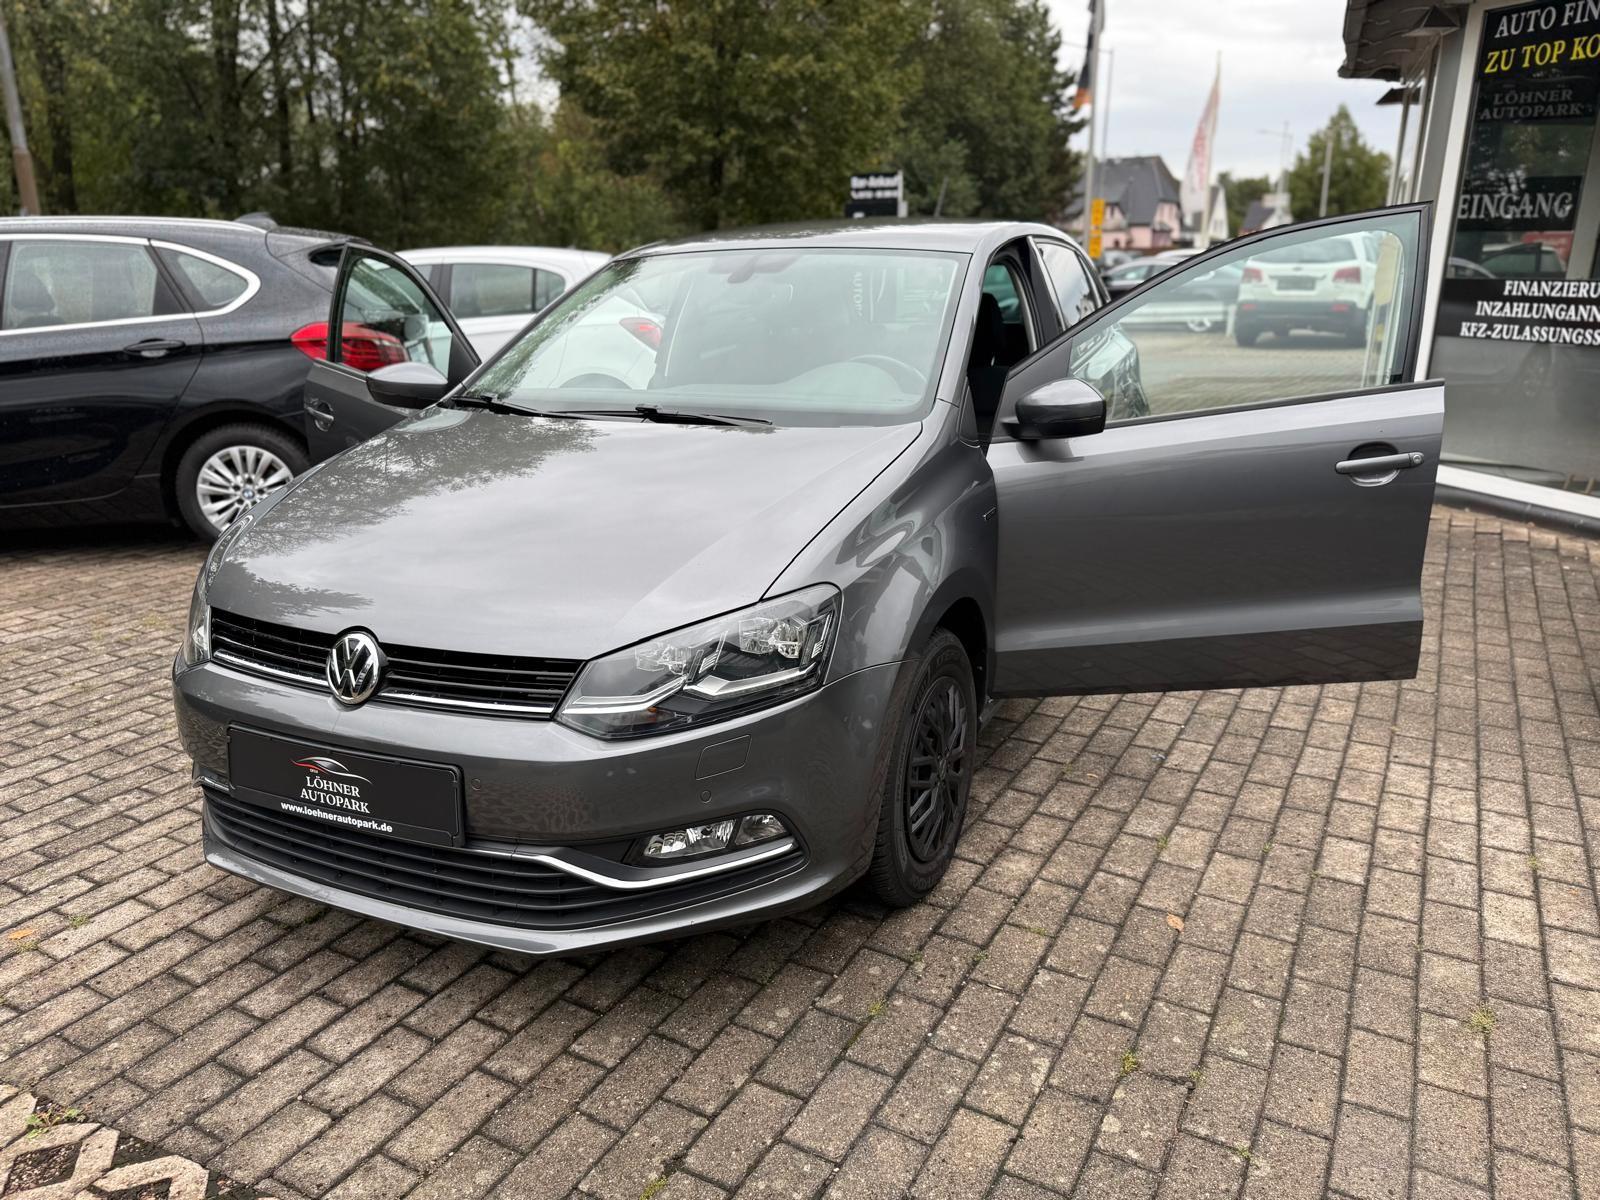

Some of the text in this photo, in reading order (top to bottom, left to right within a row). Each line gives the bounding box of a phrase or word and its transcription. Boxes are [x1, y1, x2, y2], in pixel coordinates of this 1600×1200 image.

[1494, 6, 1556, 38] AUTO
[1484, 34, 1600, 74] ZU TOP KO
[1492, 88, 1573, 106] LÖHNER
[1480, 103, 1583, 120] AUTOPARK
[1457, 192, 1573, 219] EINGANG
[1503, 280, 1600, 298] FINANZIERU
[1460, 322, 1600, 345] KFZ-ZULASSUNGSS
[306, 775, 361, 798] LÖHNER
[300, 788, 370, 814] AUTOPARK
[280, 801, 393, 833] www.loehnerautopark.de
